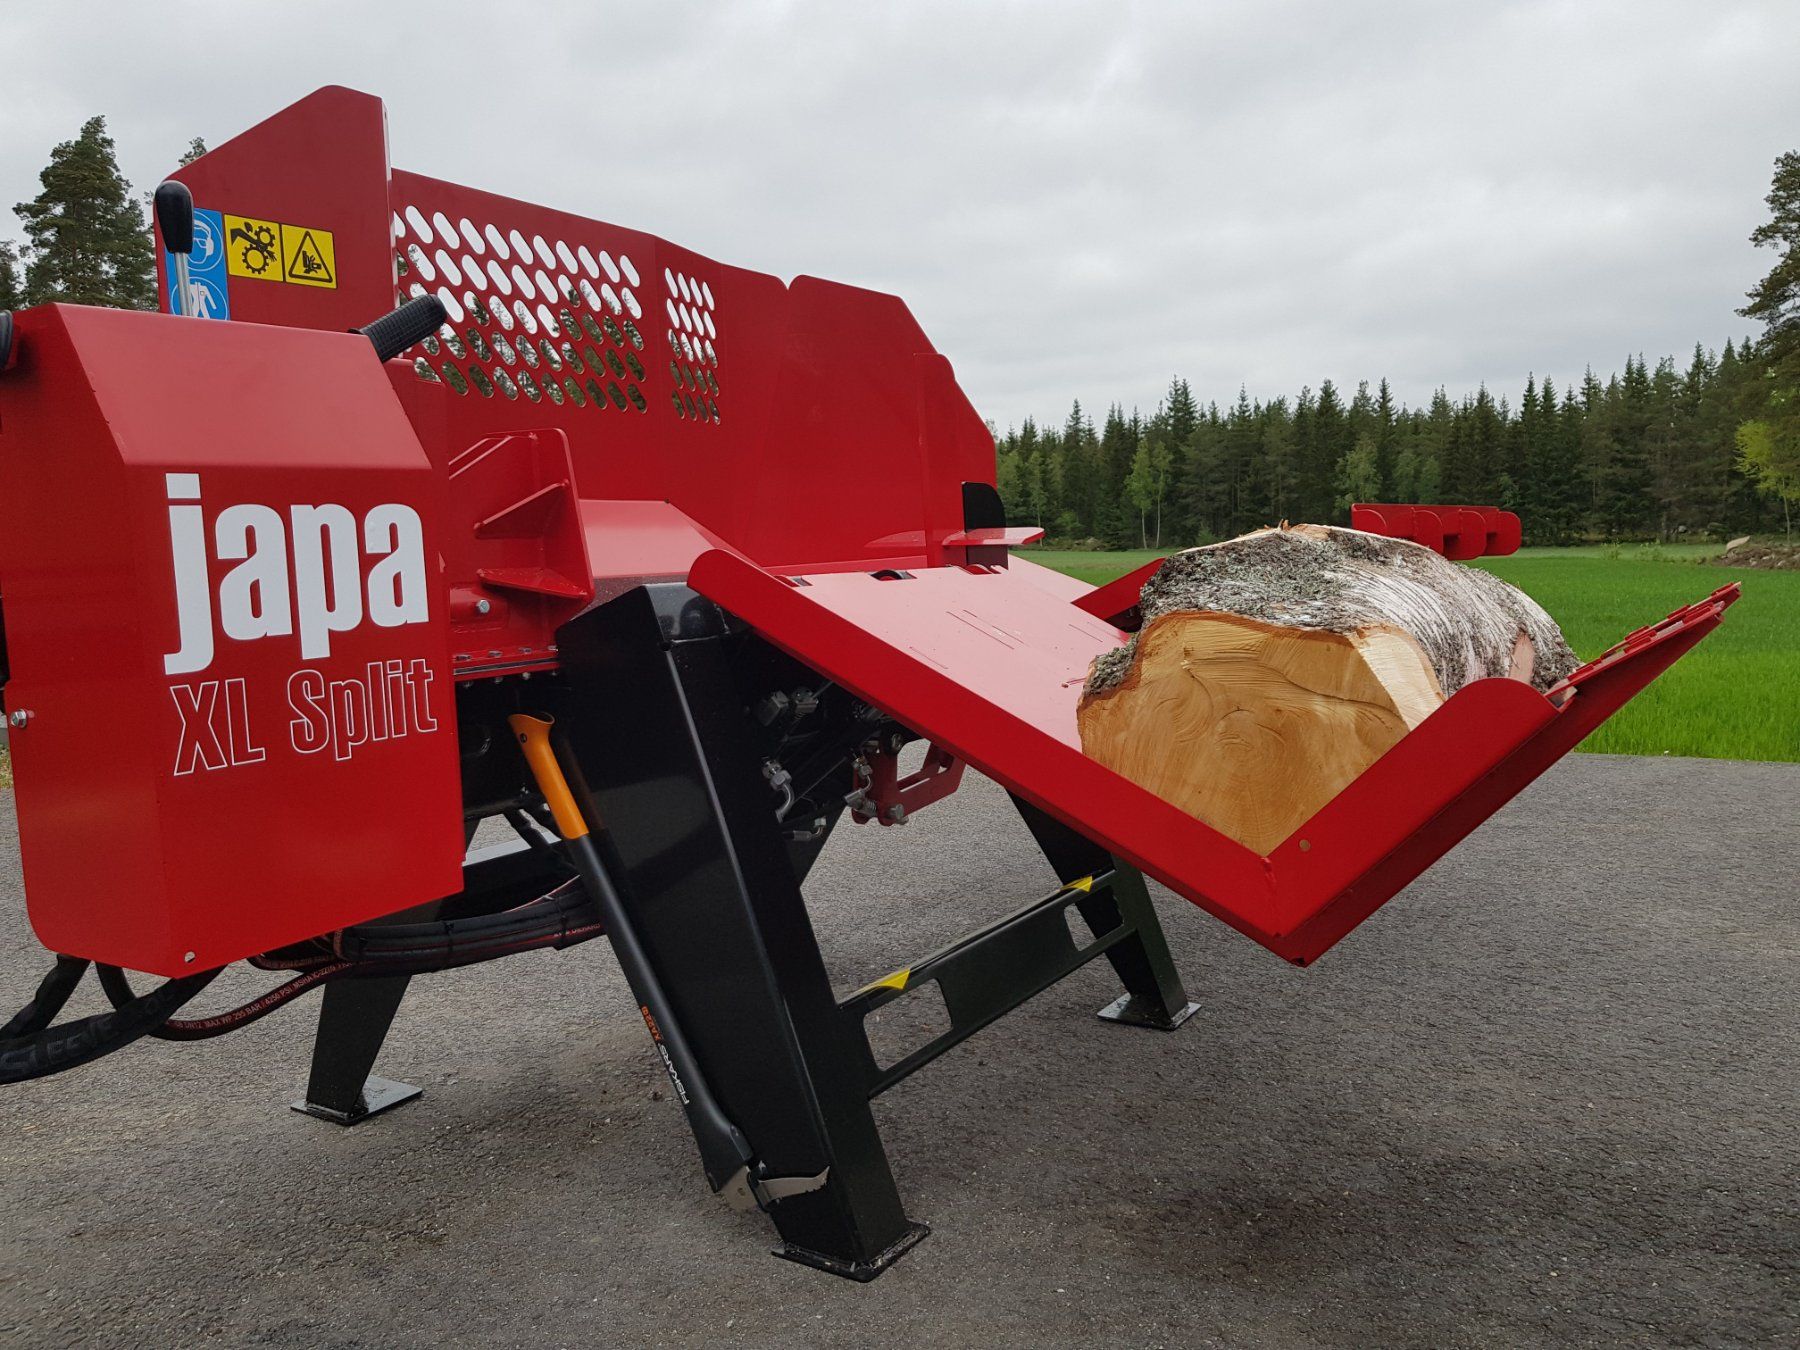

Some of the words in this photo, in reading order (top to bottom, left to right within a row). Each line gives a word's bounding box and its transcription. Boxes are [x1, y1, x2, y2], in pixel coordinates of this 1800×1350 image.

[163, 472, 430, 675] japa
[169, 677, 266, 776] XL
[287, 658, 438, 761] Split
[244, 1002, 262, 1016] BAR
[659, 1045, 690, 1105] FISKARS
